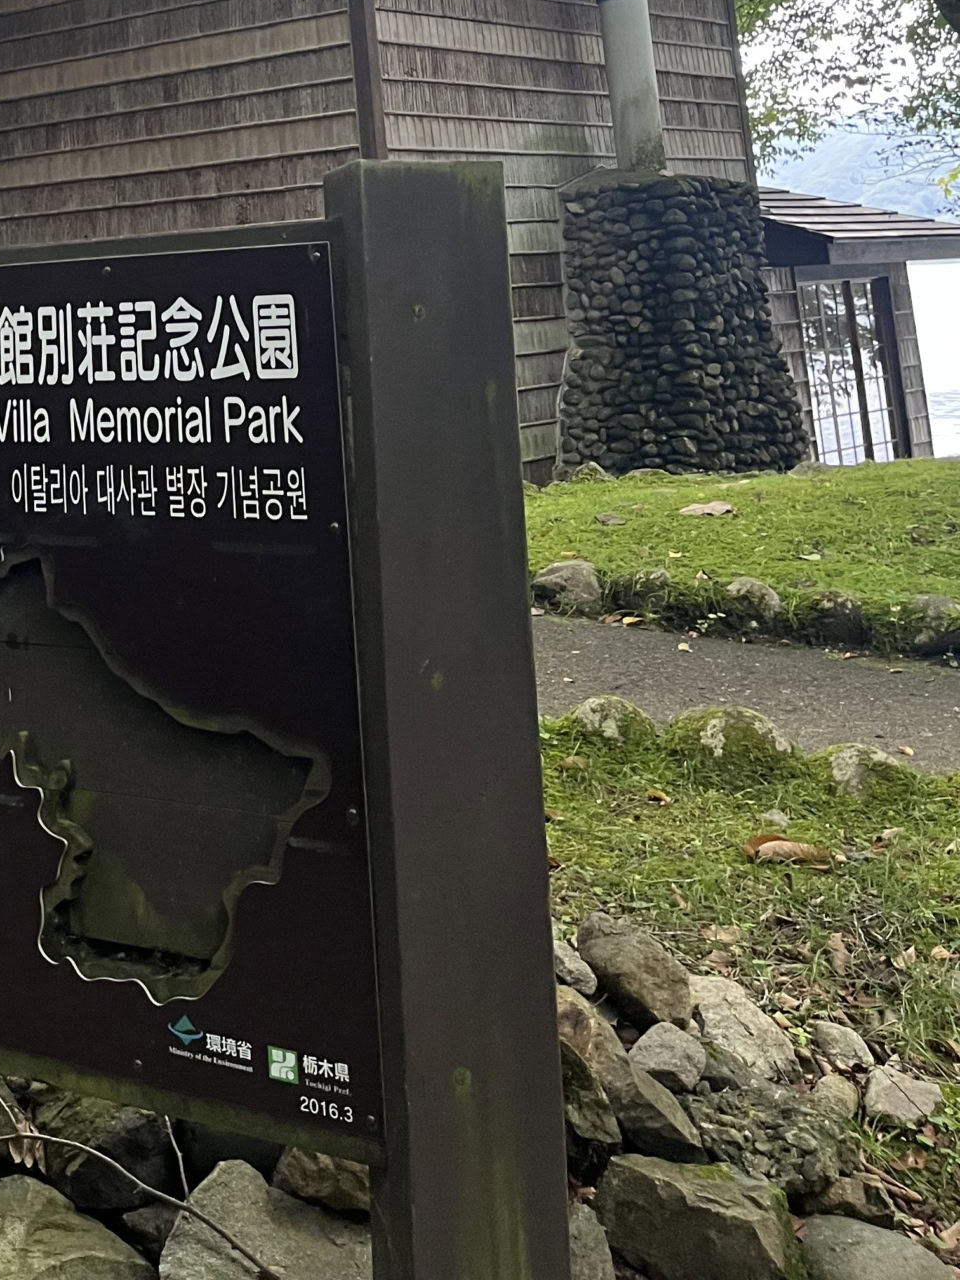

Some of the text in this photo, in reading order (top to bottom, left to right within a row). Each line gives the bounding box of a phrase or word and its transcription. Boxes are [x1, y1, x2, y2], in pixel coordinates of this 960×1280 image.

[69, 395, 212, 444] Memorial
[223, 395, 304, 444] Park
[11, 463, 308, 521] 이탈리아 대사관 별장 기념공원
[168, 1046, 194, 1060] Ministry
[202, 1055, 212, 1063] the
[206, 1033, 252, 1061] 環境省
[302, 1054, 350, 1083] 栃木県
[305, 1078, 332, 1092] Tochigi
[300, 1095, 354, 1123] 2016.3
